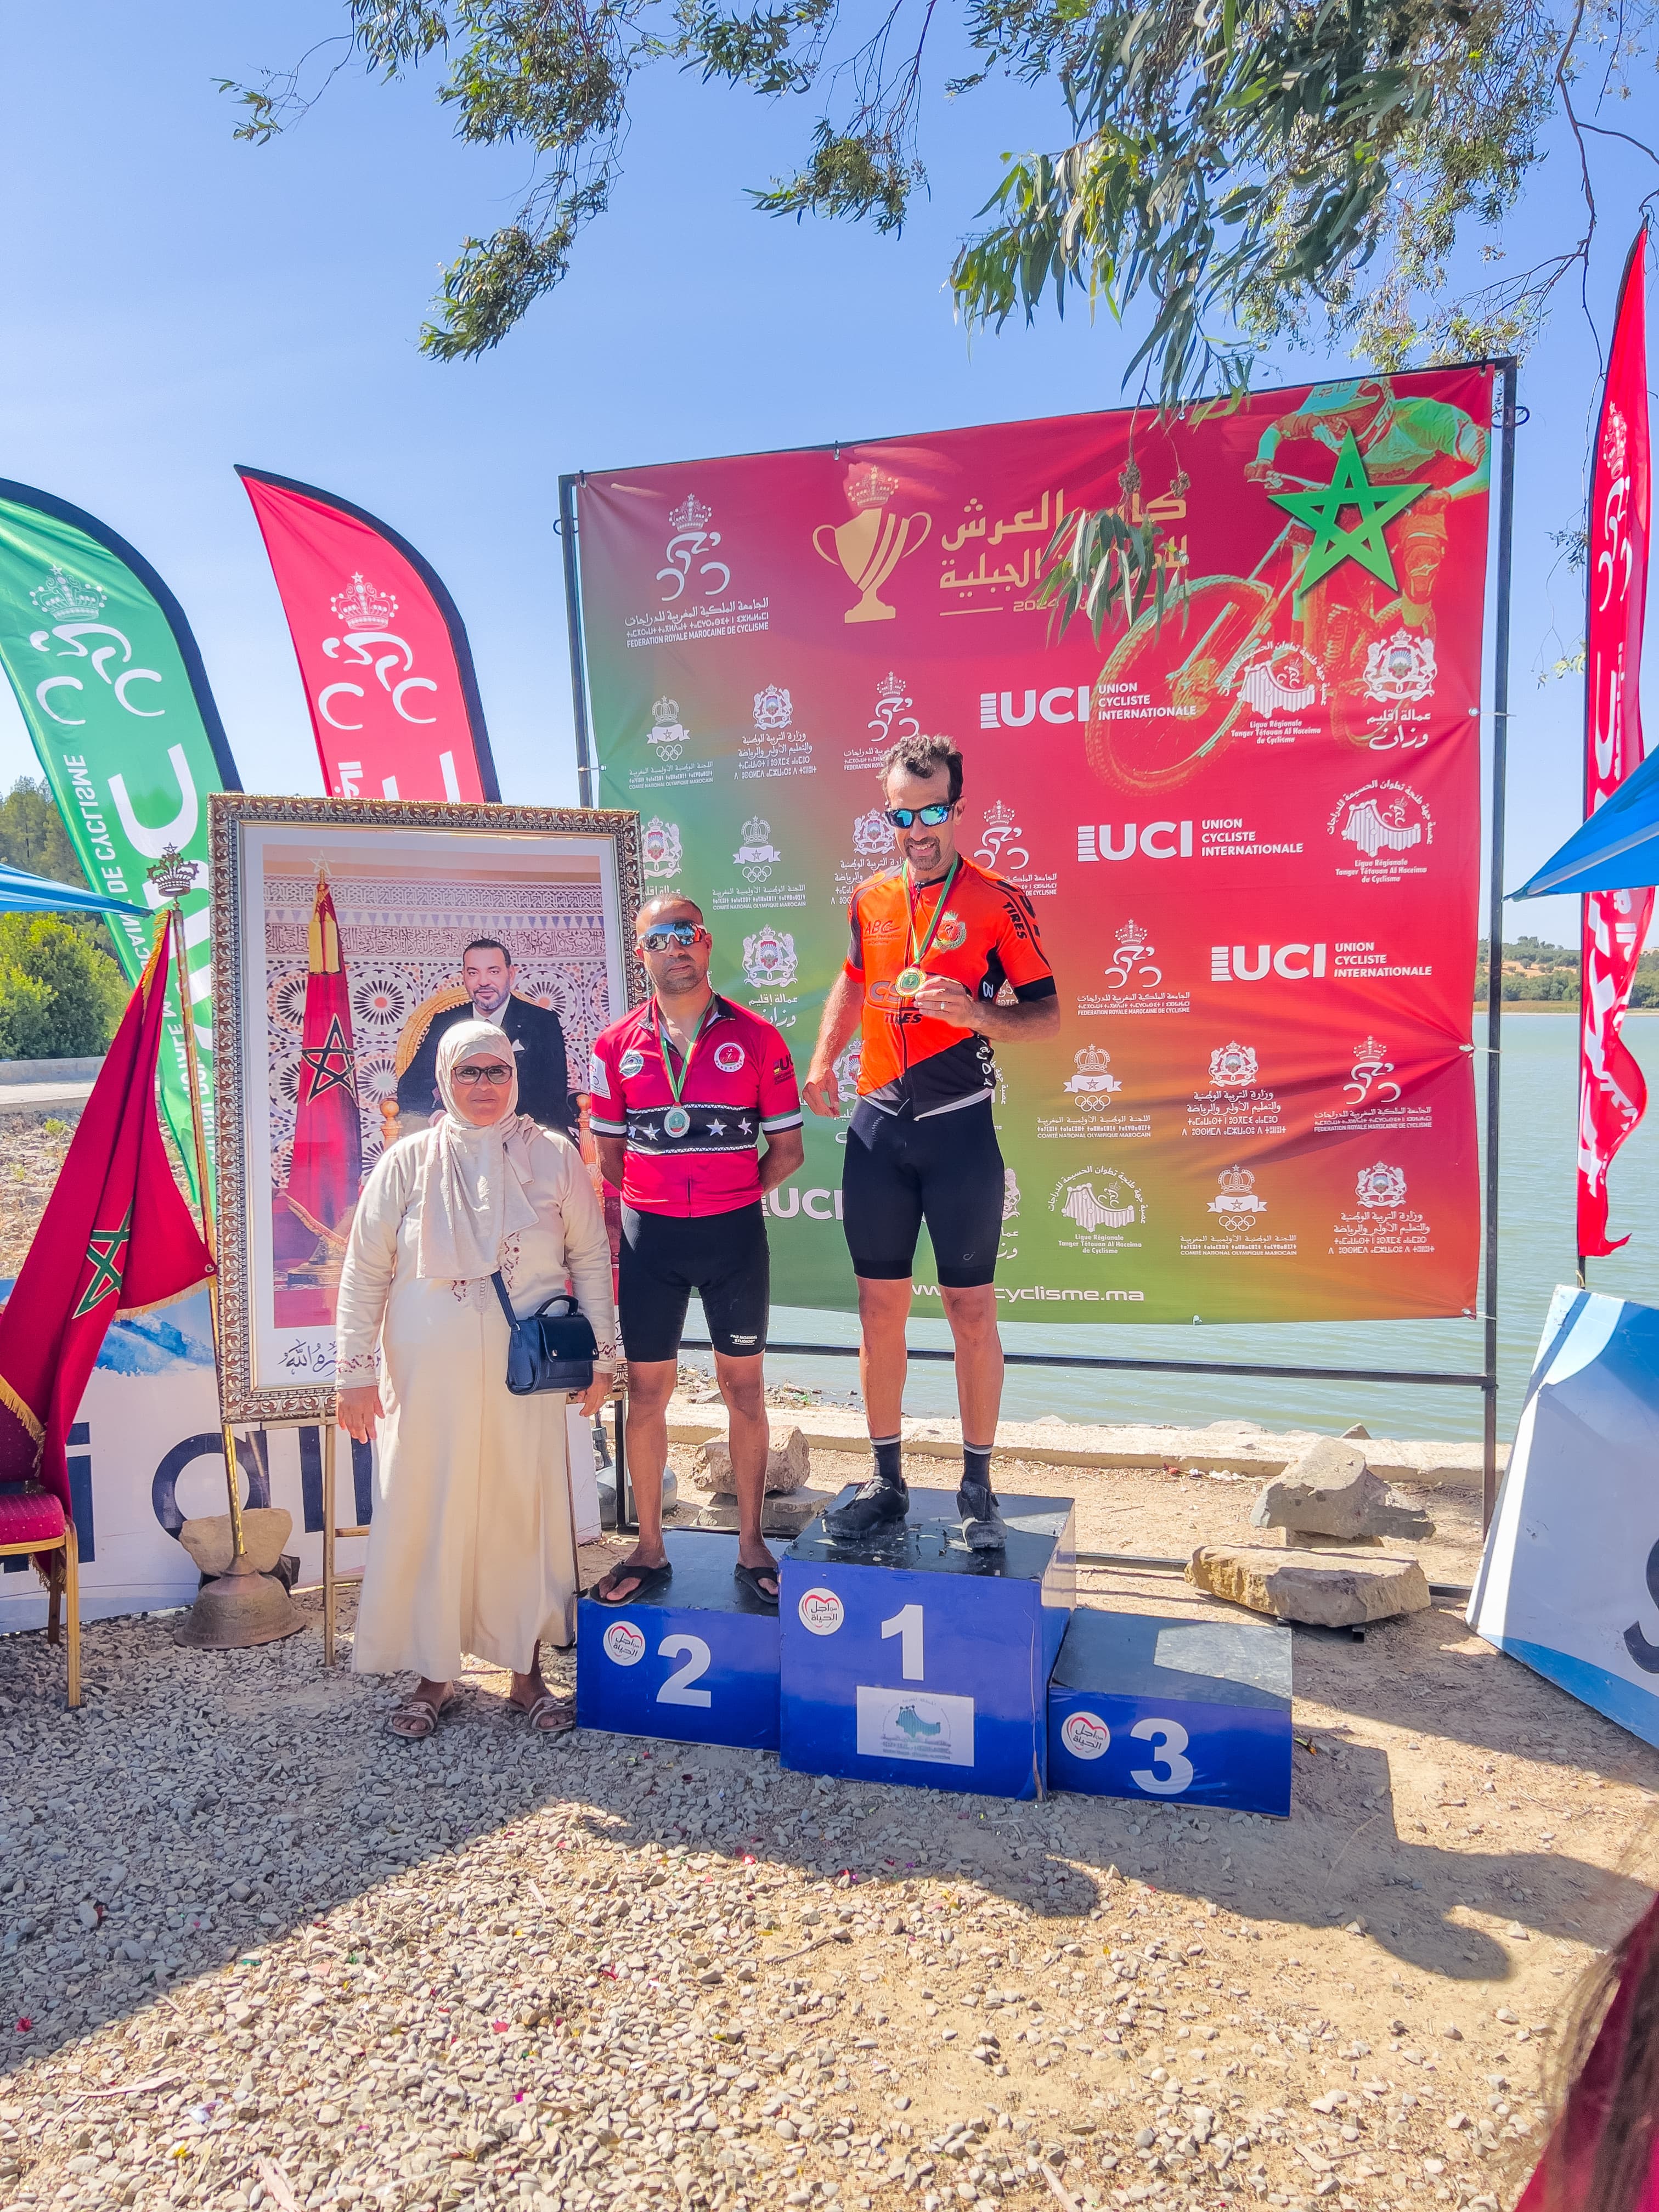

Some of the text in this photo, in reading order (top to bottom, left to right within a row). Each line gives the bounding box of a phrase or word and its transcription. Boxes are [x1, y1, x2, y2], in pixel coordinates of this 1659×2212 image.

[941, 488, 1064, 551] العرش
[939, 548, 1041, 597] الجبلية
[1013, 598, 1059, 612] 2024
[625, 597, 768, 627] الجامعة الملكية المغربية للدراجات
[627, 621, 768, 648] FEDERATION ROYALE MAROCAINE DE CYCLISME
[1098, 682, 1137, 694] UNION
[1001, 686, 1090, 727] UCI
[1098, 694, 1150, 707] CYCLISTE
[1098, 705, 1197, 720] INTERNATIONALE
[1367, 709, 1431, 725] عمالة إقليم
[742, 730, 806, 746] وزارة التربية الوطنية
[1369, 725, 1429, 751] وزان
[738, 746, 764, 760] والرياضة
[788, 742, 812, 756] والتعليم
[843, 748, 873, 758] للدراجات
[1379, 779, 1405, 791] تطوان
[1201, 819, 1243, 830] UNION
[1099, 820, 1193, 861] UCI
[1201, 831, 1256, 844] CYCLISTE
[1201, 843, 1304, 857] INTERNATIONALE
[840, 856, 904, 870] زارة التربية الوطنية
[834, 872, 863, 884] والرياضة
[1034, 873, 1057, 882] الجامعة
[1335, 942, 1375, 952] UNION
[1233, 943, 1327, 980] UCI
[1335, 954, 1387, 965] CYCLISTE
[1334, 966, 1432, 978] INTERNATIONALE
[748, 994, 798, 1006] عمالة إقليم
[1077, 995, 1110, 1003] للدراجات
[1112, 994, 1136, 1003] المغربية
[1138, 993, 1165, 1001] الملكية
[995, 1068, 1009, 1105] عصبة جهة
[1193, 1090, 1274, 1102] وزارة التربية الوطنية
[1187, 1103, 1221, 1116] والرياضة
[1252, 1102, 1282, 1114] والتعليم
[1037, 1116, 1063, 1126] المغربية
[1100, 1115, 1126, 1124] الوطنية
[1048, 1165, 1149, 1224] عصبة جهة طنجة تطوان الحسيمة للدراجات
[769, 1188, 843, 1220] UCI
[1341, 1210, 1423, 1223] وزارة التربية الوطنية
[1333, 1224, 1368, 1235] والرياضة
[1400, 1223, 1431, 1235] والتعليم
[1180, 1235, 1207, 1244] المغربية
[1245, 1235, 1272, 1243] الوطنية
[811, 1613, 838, 1623] الحياة
[881, 1604, 924, 1681] 1
[613, 1643, 638, 1657] الحياة
[656, 1634, 711, 1708] 2
[1073, 1735, 1102, 1750] الحياة
[1130, 1718, 1194, 1795] 3
